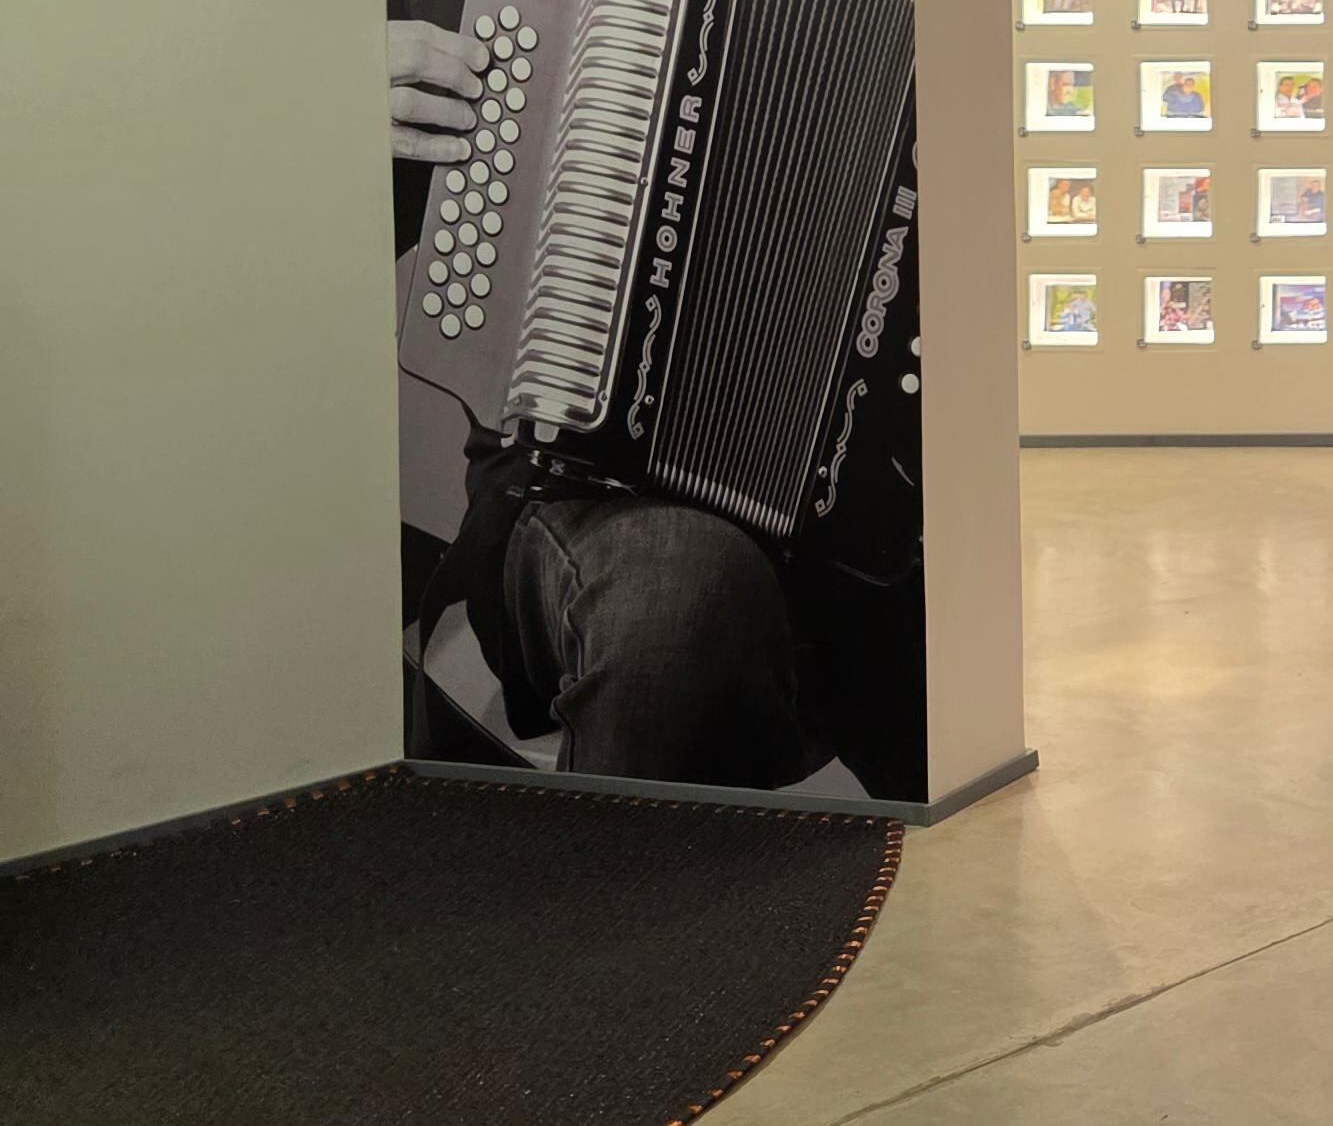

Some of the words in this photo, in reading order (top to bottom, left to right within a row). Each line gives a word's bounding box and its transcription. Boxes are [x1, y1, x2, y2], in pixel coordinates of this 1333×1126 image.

[649, 94, 703, 289] HOHNER
[856, 226, 909, 358] CORONA
[893, 185, 917, 221] III
